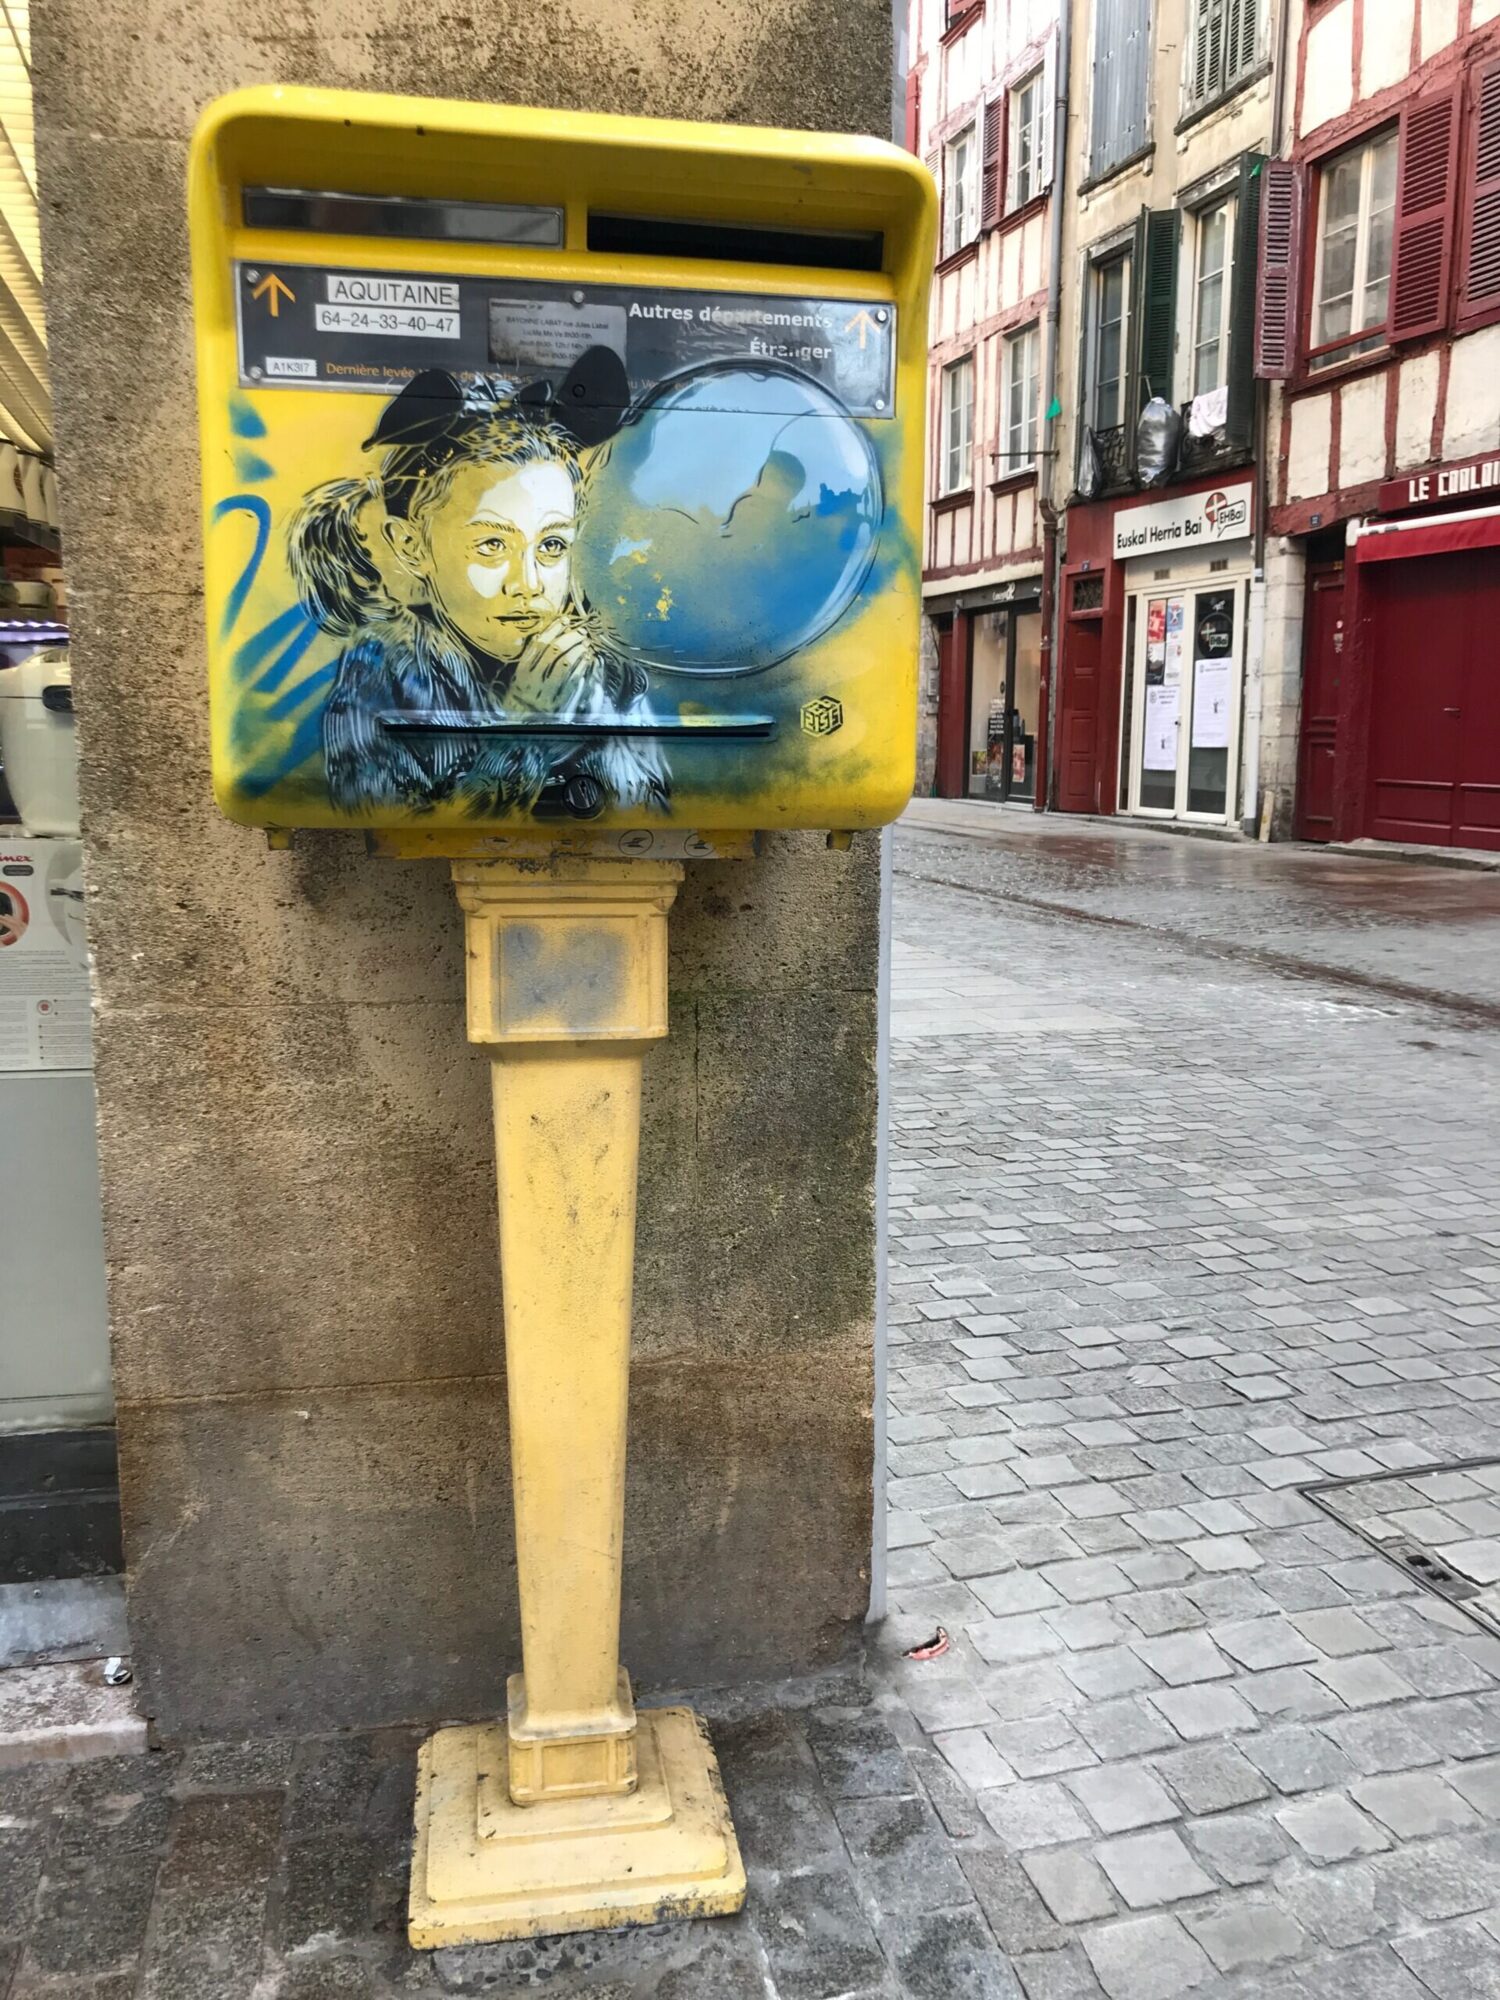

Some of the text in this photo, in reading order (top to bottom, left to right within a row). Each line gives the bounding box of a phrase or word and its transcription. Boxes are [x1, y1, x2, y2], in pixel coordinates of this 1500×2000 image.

[334, 280, 454, 306] AQUITAINE
[321, 311, 454, 333] 64-24-33-40-47
[629, 303, 833, 329] Autres départements
[749, 336, 832, 360] Étranger
[325, 363, 380, 376] Dernière
[383, 366, 416, 378] levée
[1409, 476, 1430, 503] LE
[1117, 516, 1202, 549] Euskal Herria Bai
